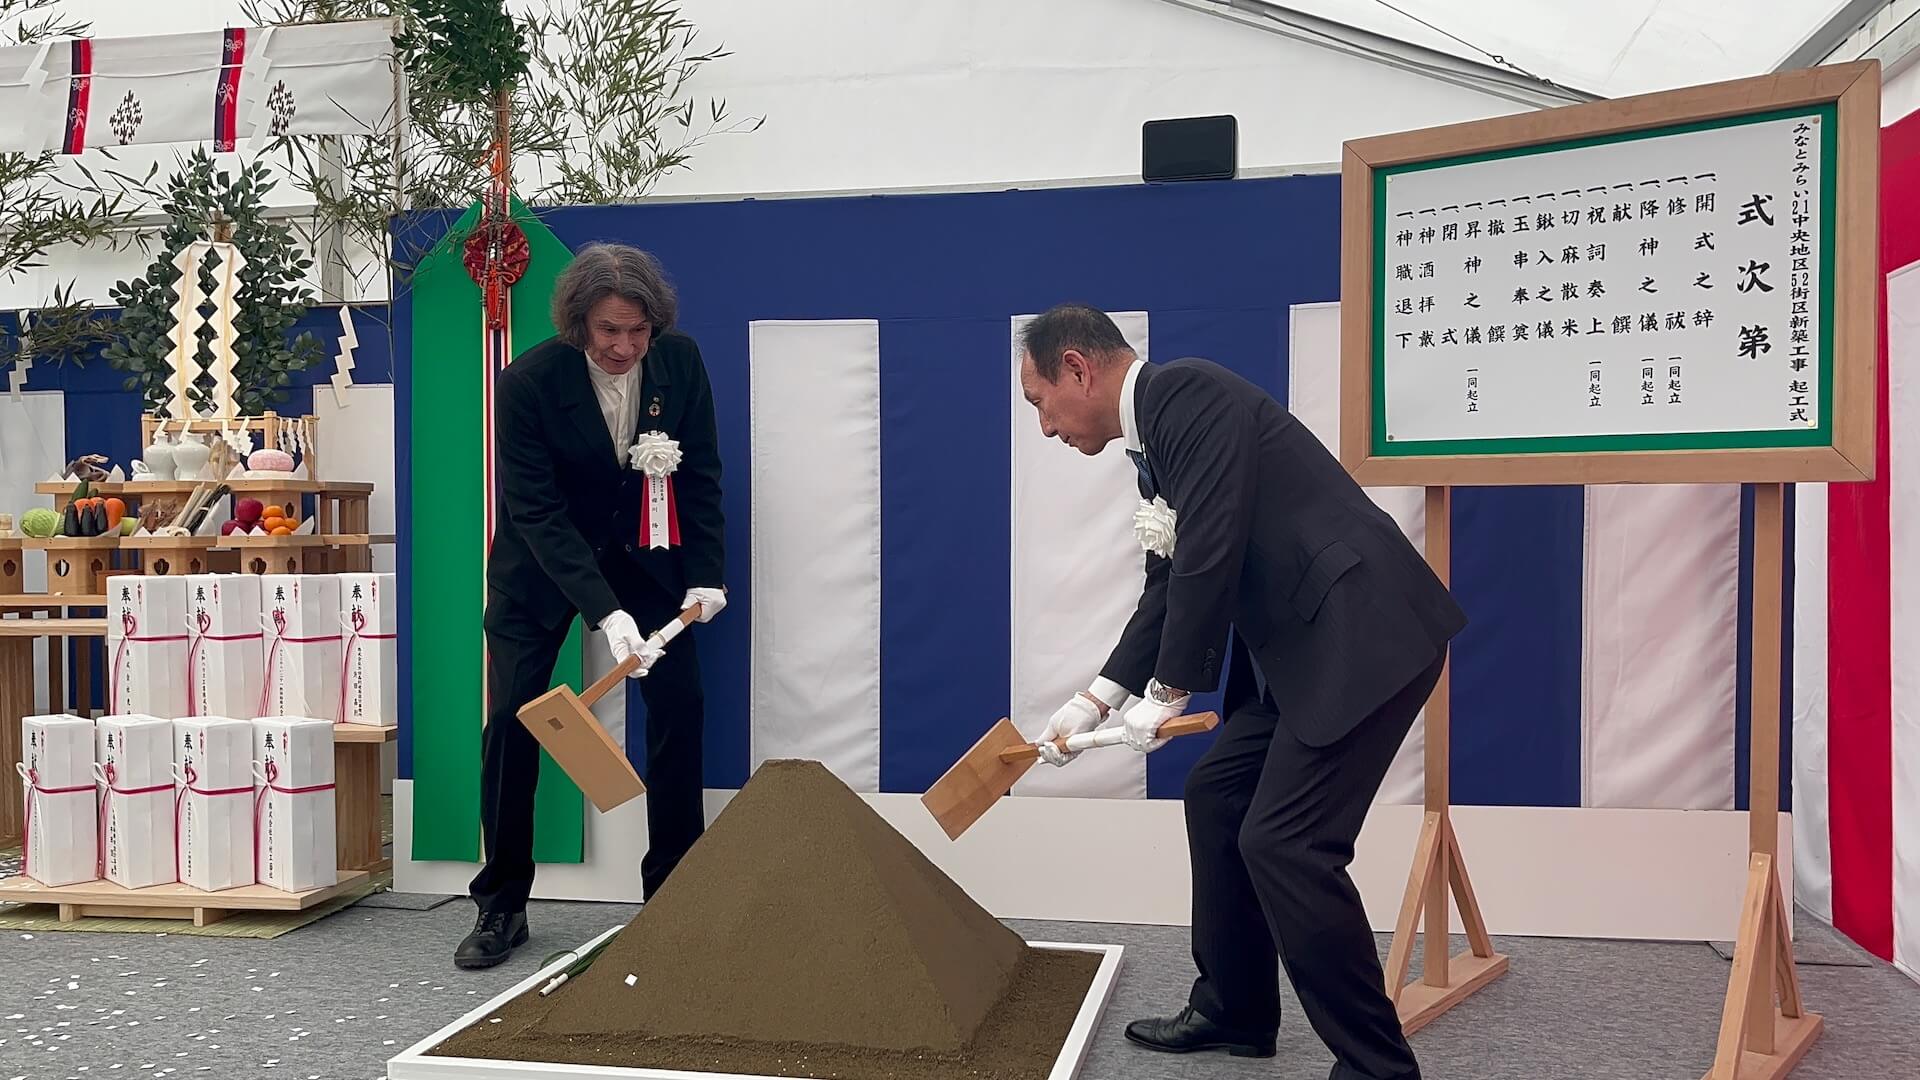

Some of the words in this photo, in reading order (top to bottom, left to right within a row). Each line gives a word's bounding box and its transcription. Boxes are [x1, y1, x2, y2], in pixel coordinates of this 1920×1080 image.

[1789, 123, 1810, 371] みなとみらい21中央地区52街区新築工事
[1737, 195, 1774, 359] 式次第
[1467, 369, 1478, 412] 一同起立
[1589, 362, 1601, 406] 一同起立
[1642, 359, 1654, 404] 一同起立
[1669, 357, 1681, 403] 一同起立
[1789, 380, 1808, 421] 起工式
